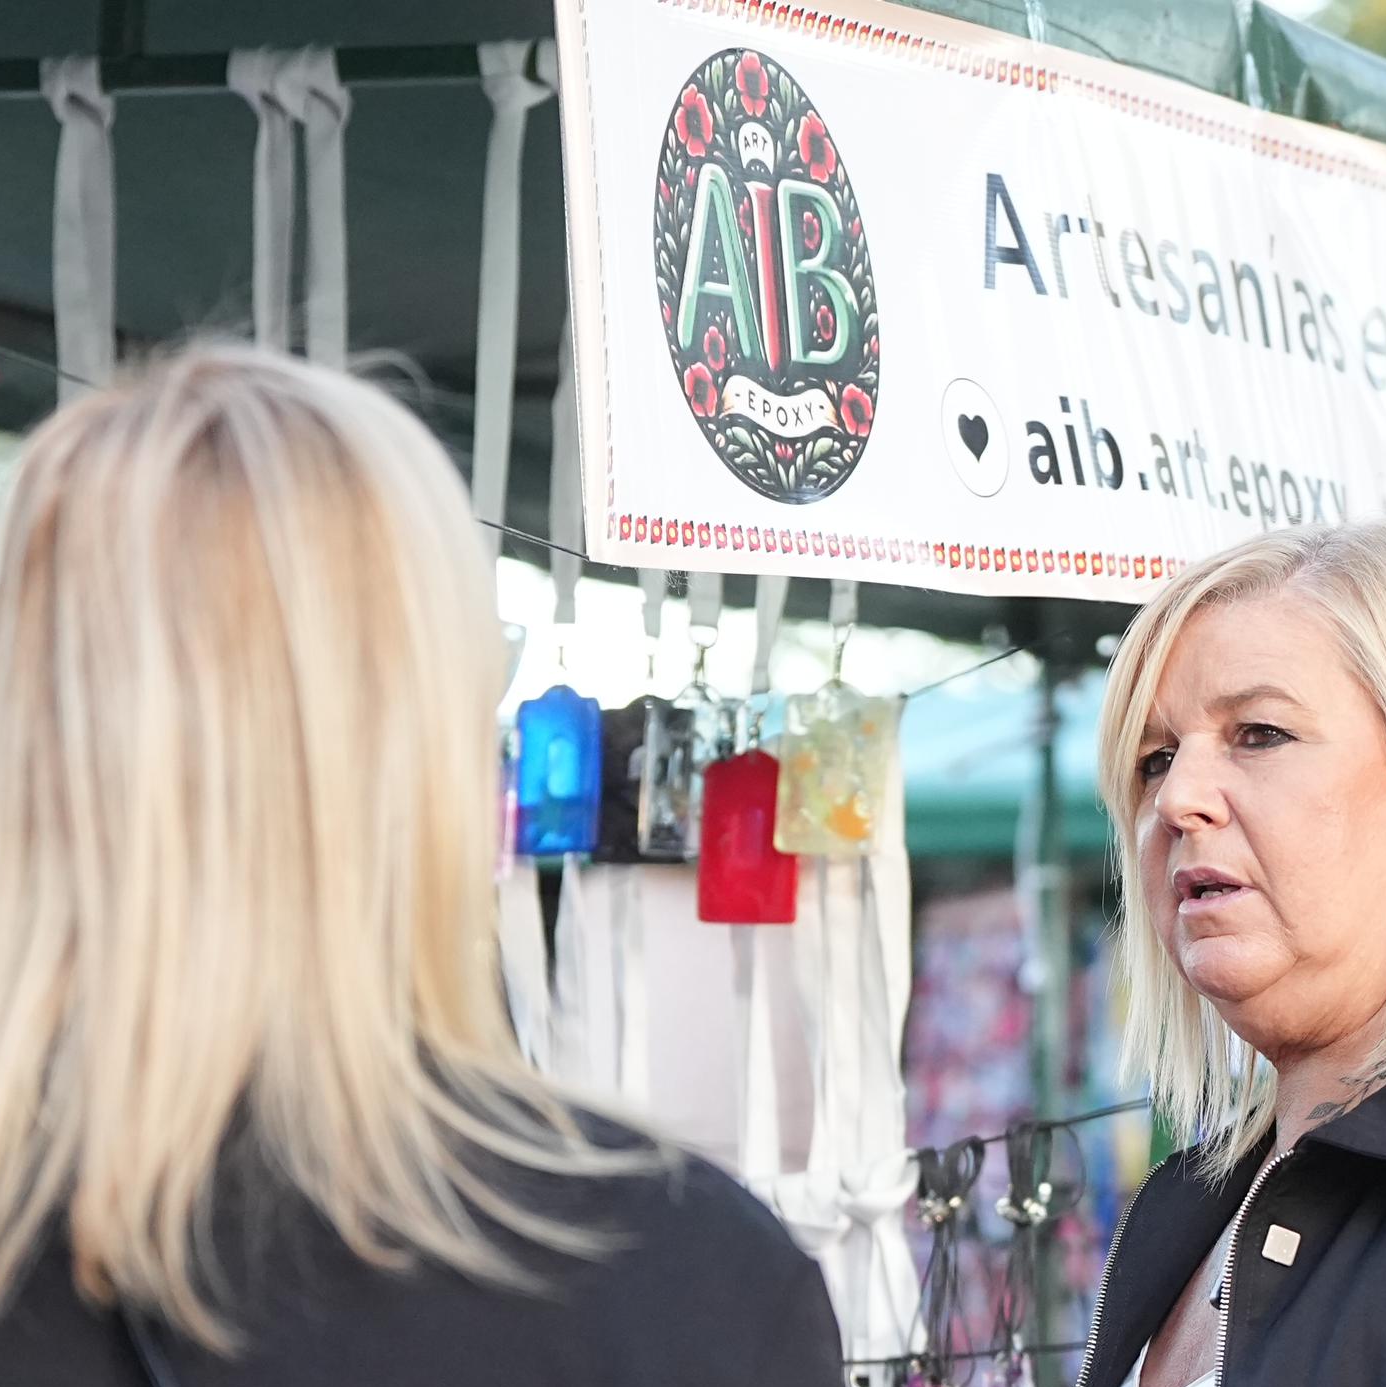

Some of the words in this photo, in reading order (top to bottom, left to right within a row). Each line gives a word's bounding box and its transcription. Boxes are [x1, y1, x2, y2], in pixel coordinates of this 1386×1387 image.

[742, 131, 769, 154] ART
[678, 163, 859, 372] AIB
[984, 172, 1345, 373] Artesanías
